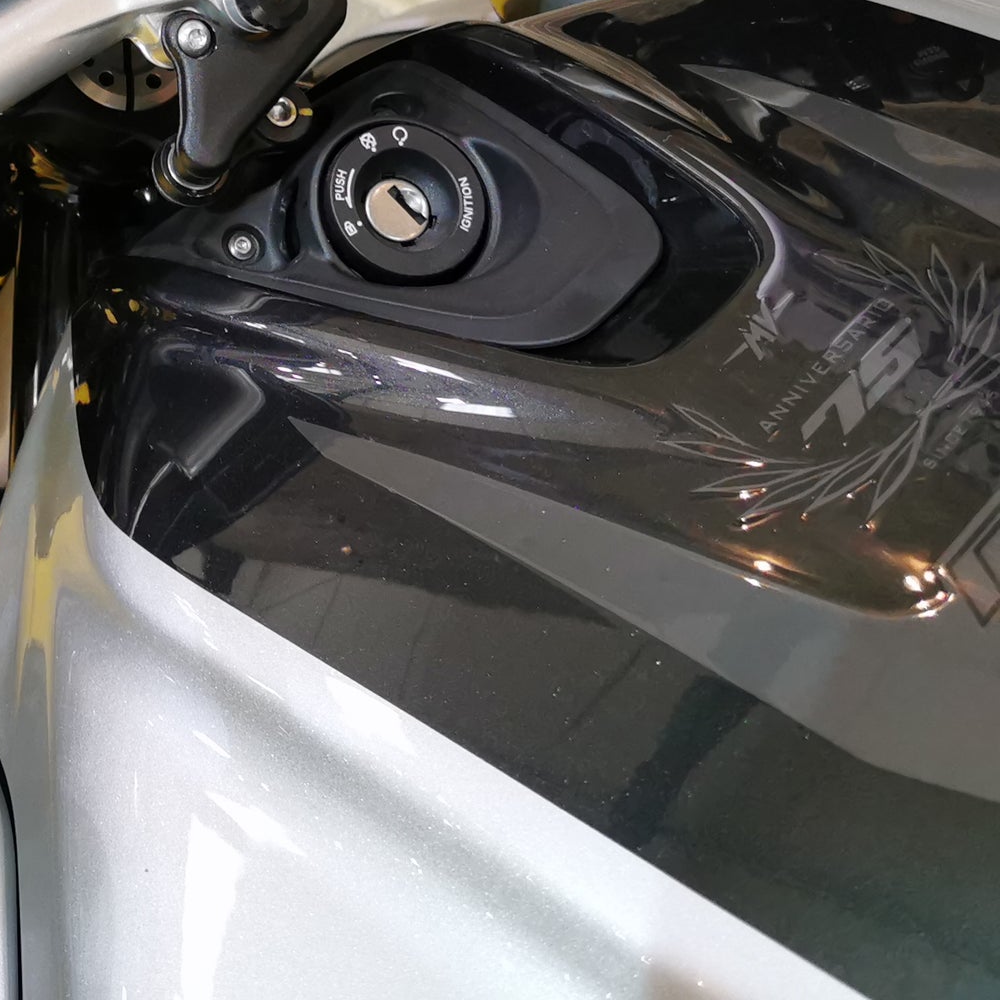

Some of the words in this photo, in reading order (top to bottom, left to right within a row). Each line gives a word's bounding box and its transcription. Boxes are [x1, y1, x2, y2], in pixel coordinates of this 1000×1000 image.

[335, 169, 347, 201] PUSH
[458, 176, 474, 233] IGNITION
[758, 297, 895, 434] ANNIVERSARIO
[801, 317, 923, 441] 75
